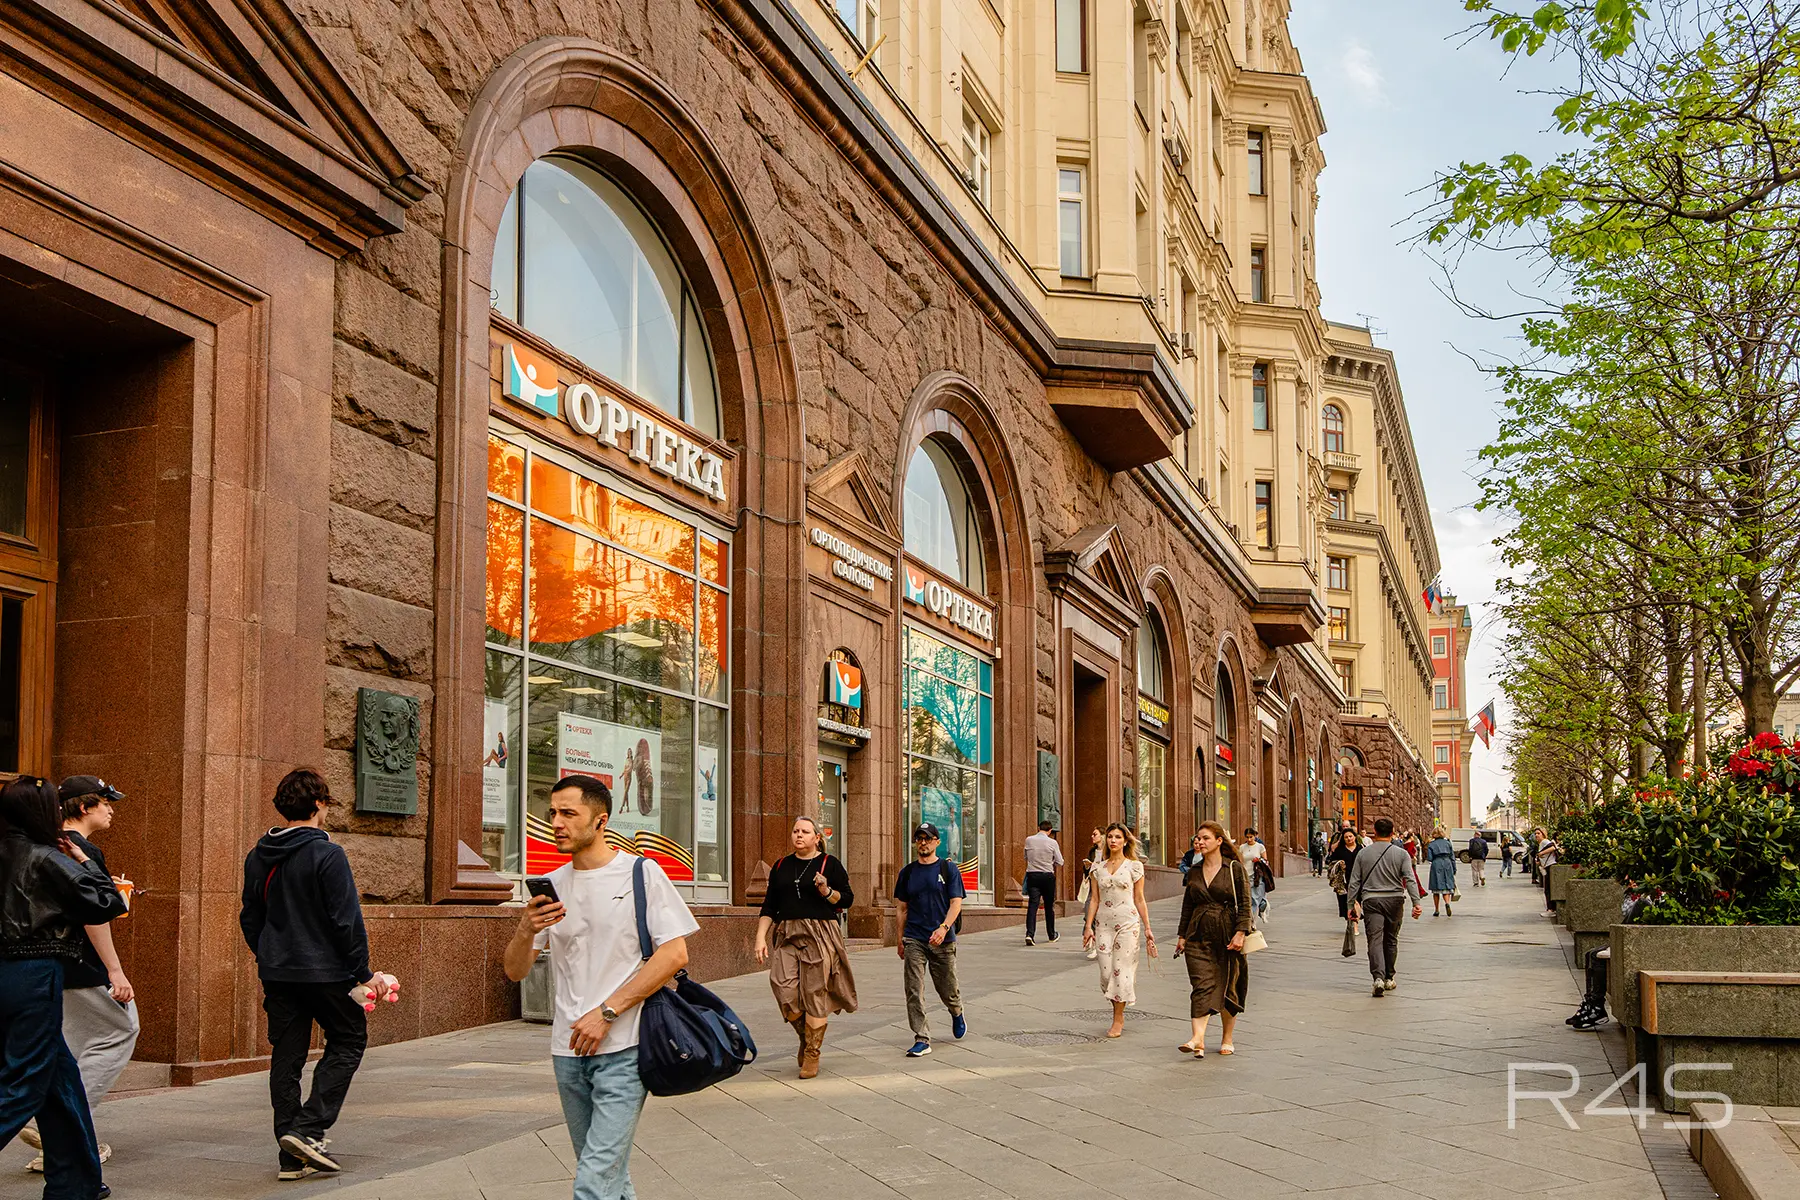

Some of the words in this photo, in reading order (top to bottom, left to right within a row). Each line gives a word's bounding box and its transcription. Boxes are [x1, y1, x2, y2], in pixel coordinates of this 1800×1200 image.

[565, 384, 726, 502] ОРТЕКА
[811, 527, 893, 582] ОРТОПЕДИЧЕСКИЕ
[833, 560, 874, 591] САЛОНЫ
[925, 581, 993, 641] ОРТЕКА
[572, 726, 592, 735] ОРТЕКА
[577, 759, 597, 768] ПРОСТО
[598, 761, 614, 769] ОБУВЬ
